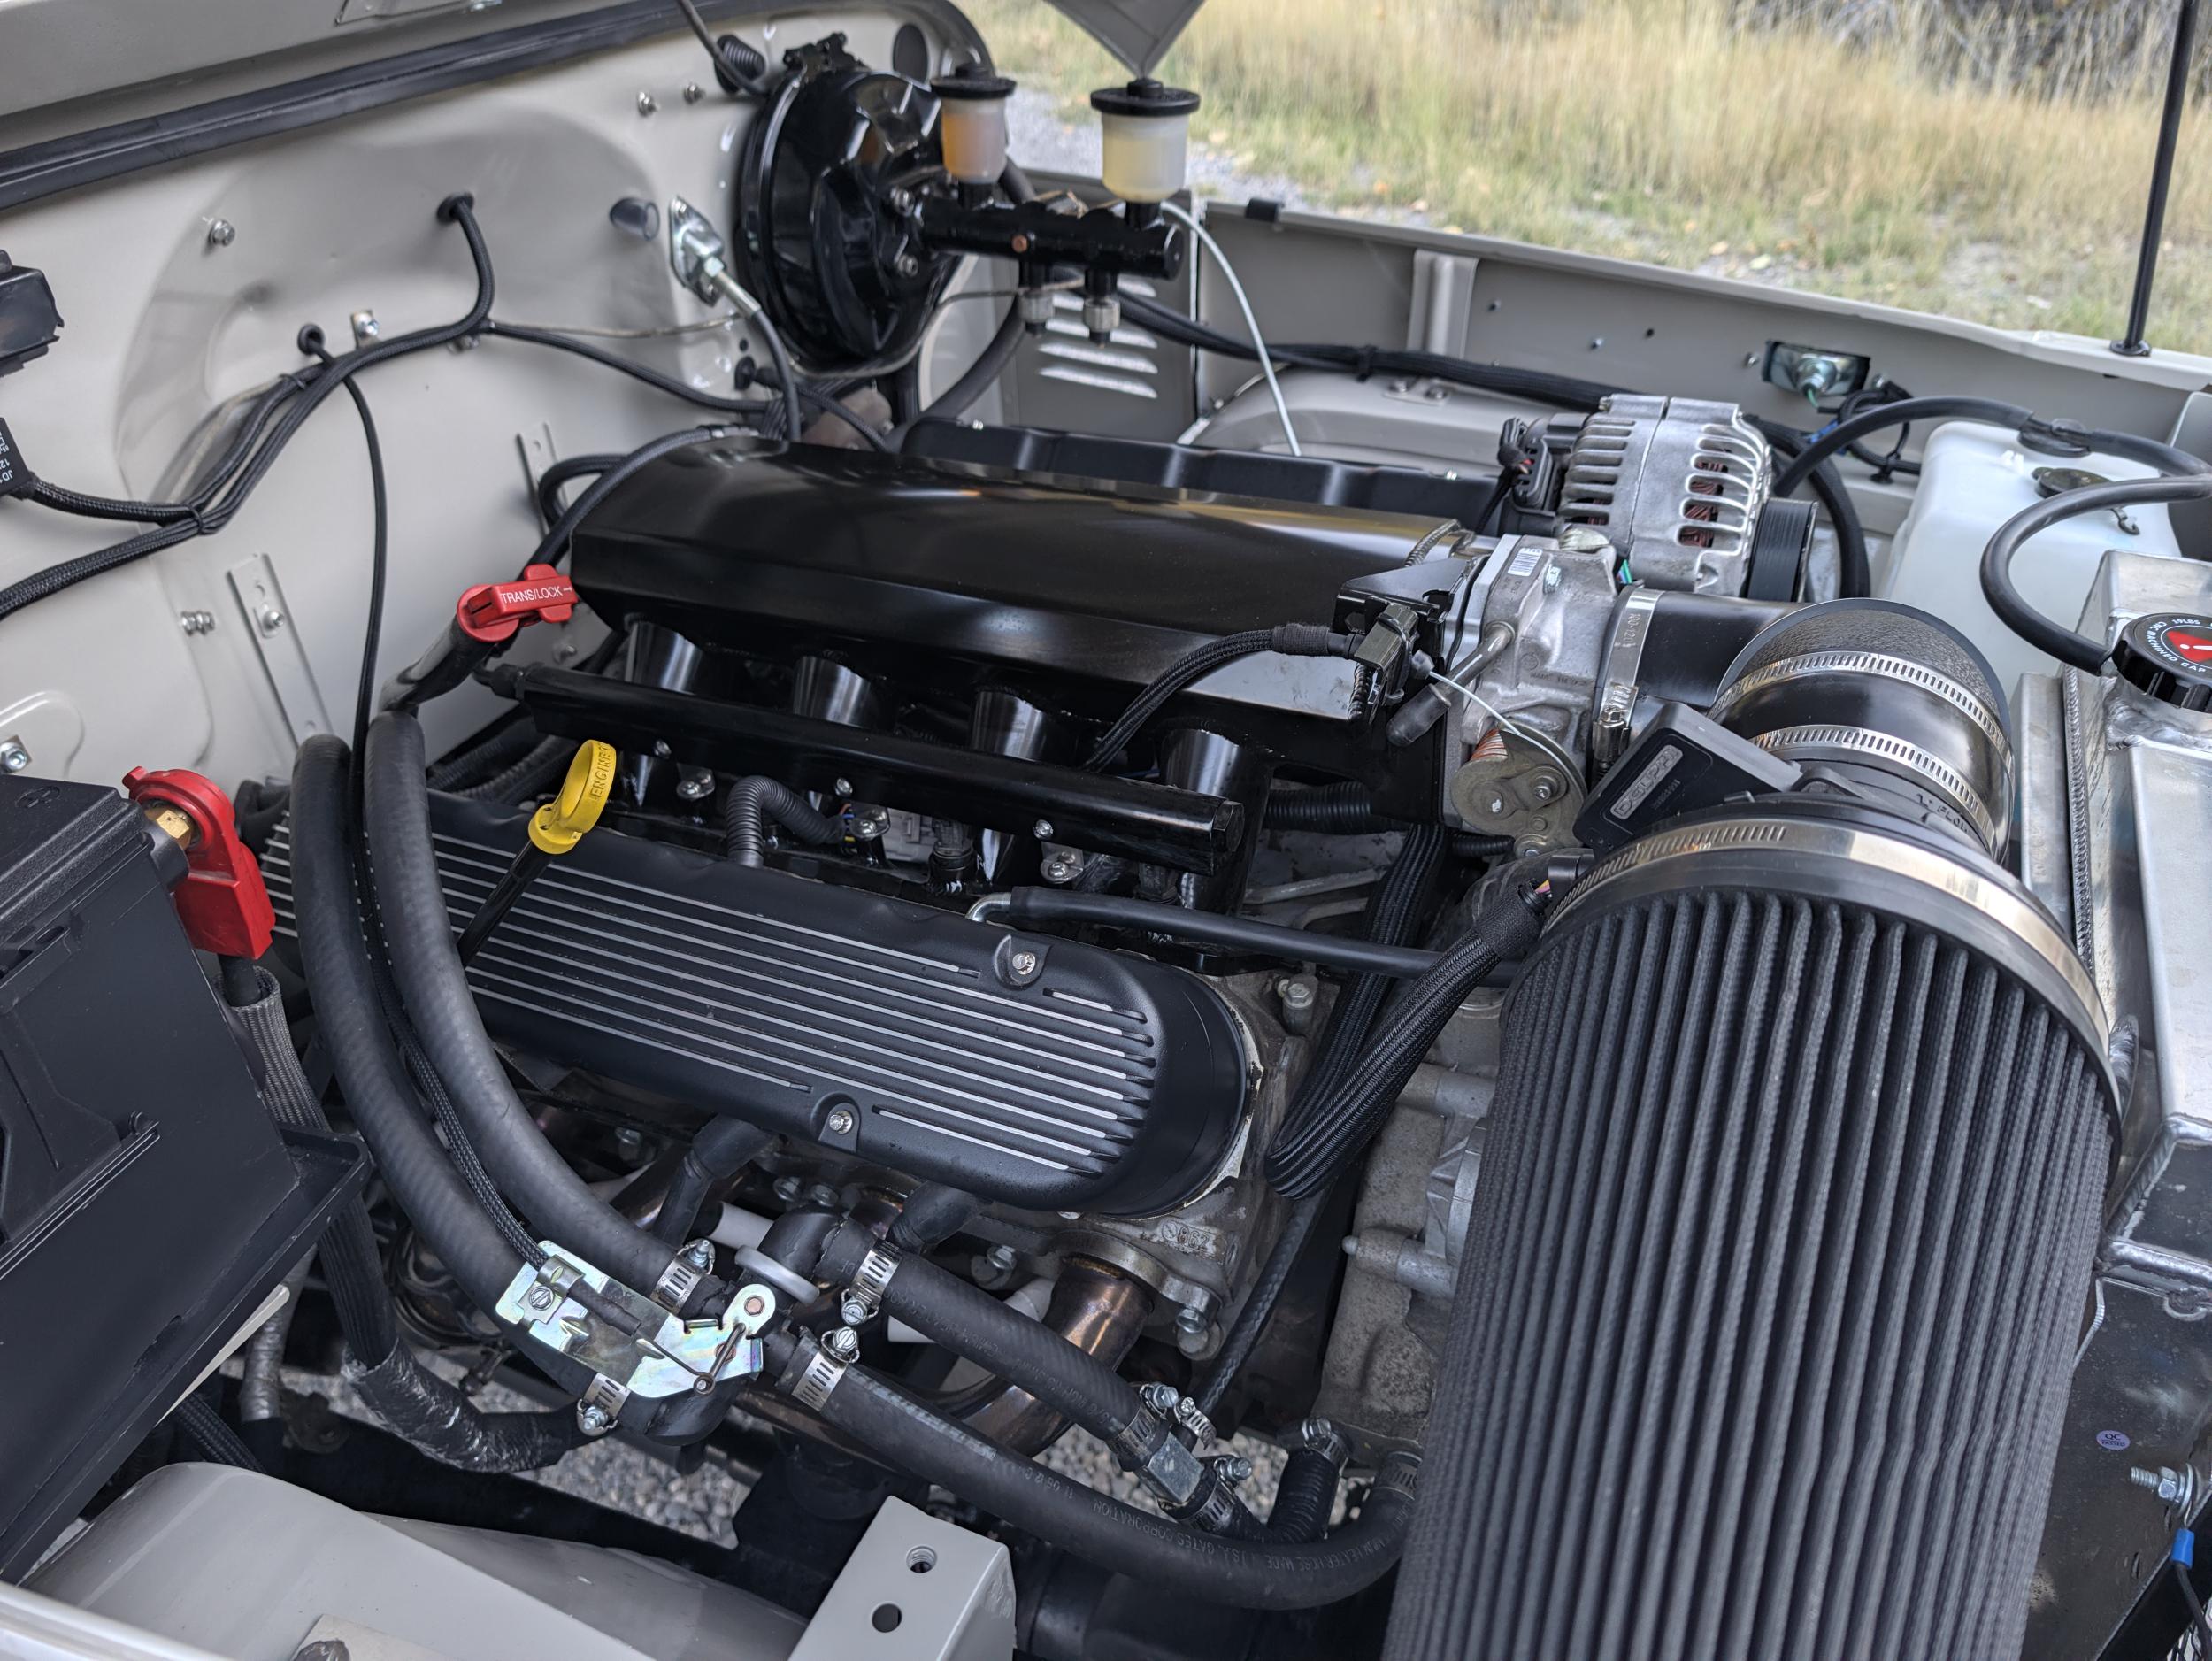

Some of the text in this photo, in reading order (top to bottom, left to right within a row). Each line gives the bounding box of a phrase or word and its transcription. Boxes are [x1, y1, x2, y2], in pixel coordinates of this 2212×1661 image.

[501, 586, 563, 604] TRANS/LOCK
[2146, 630, 2178, 662] MACHINED
[2181, 662, 2206, 672] CAP
[1178, 1227, 1210, 1250] 862
[1093, 1500, 1173, 1542] CORPORATION
